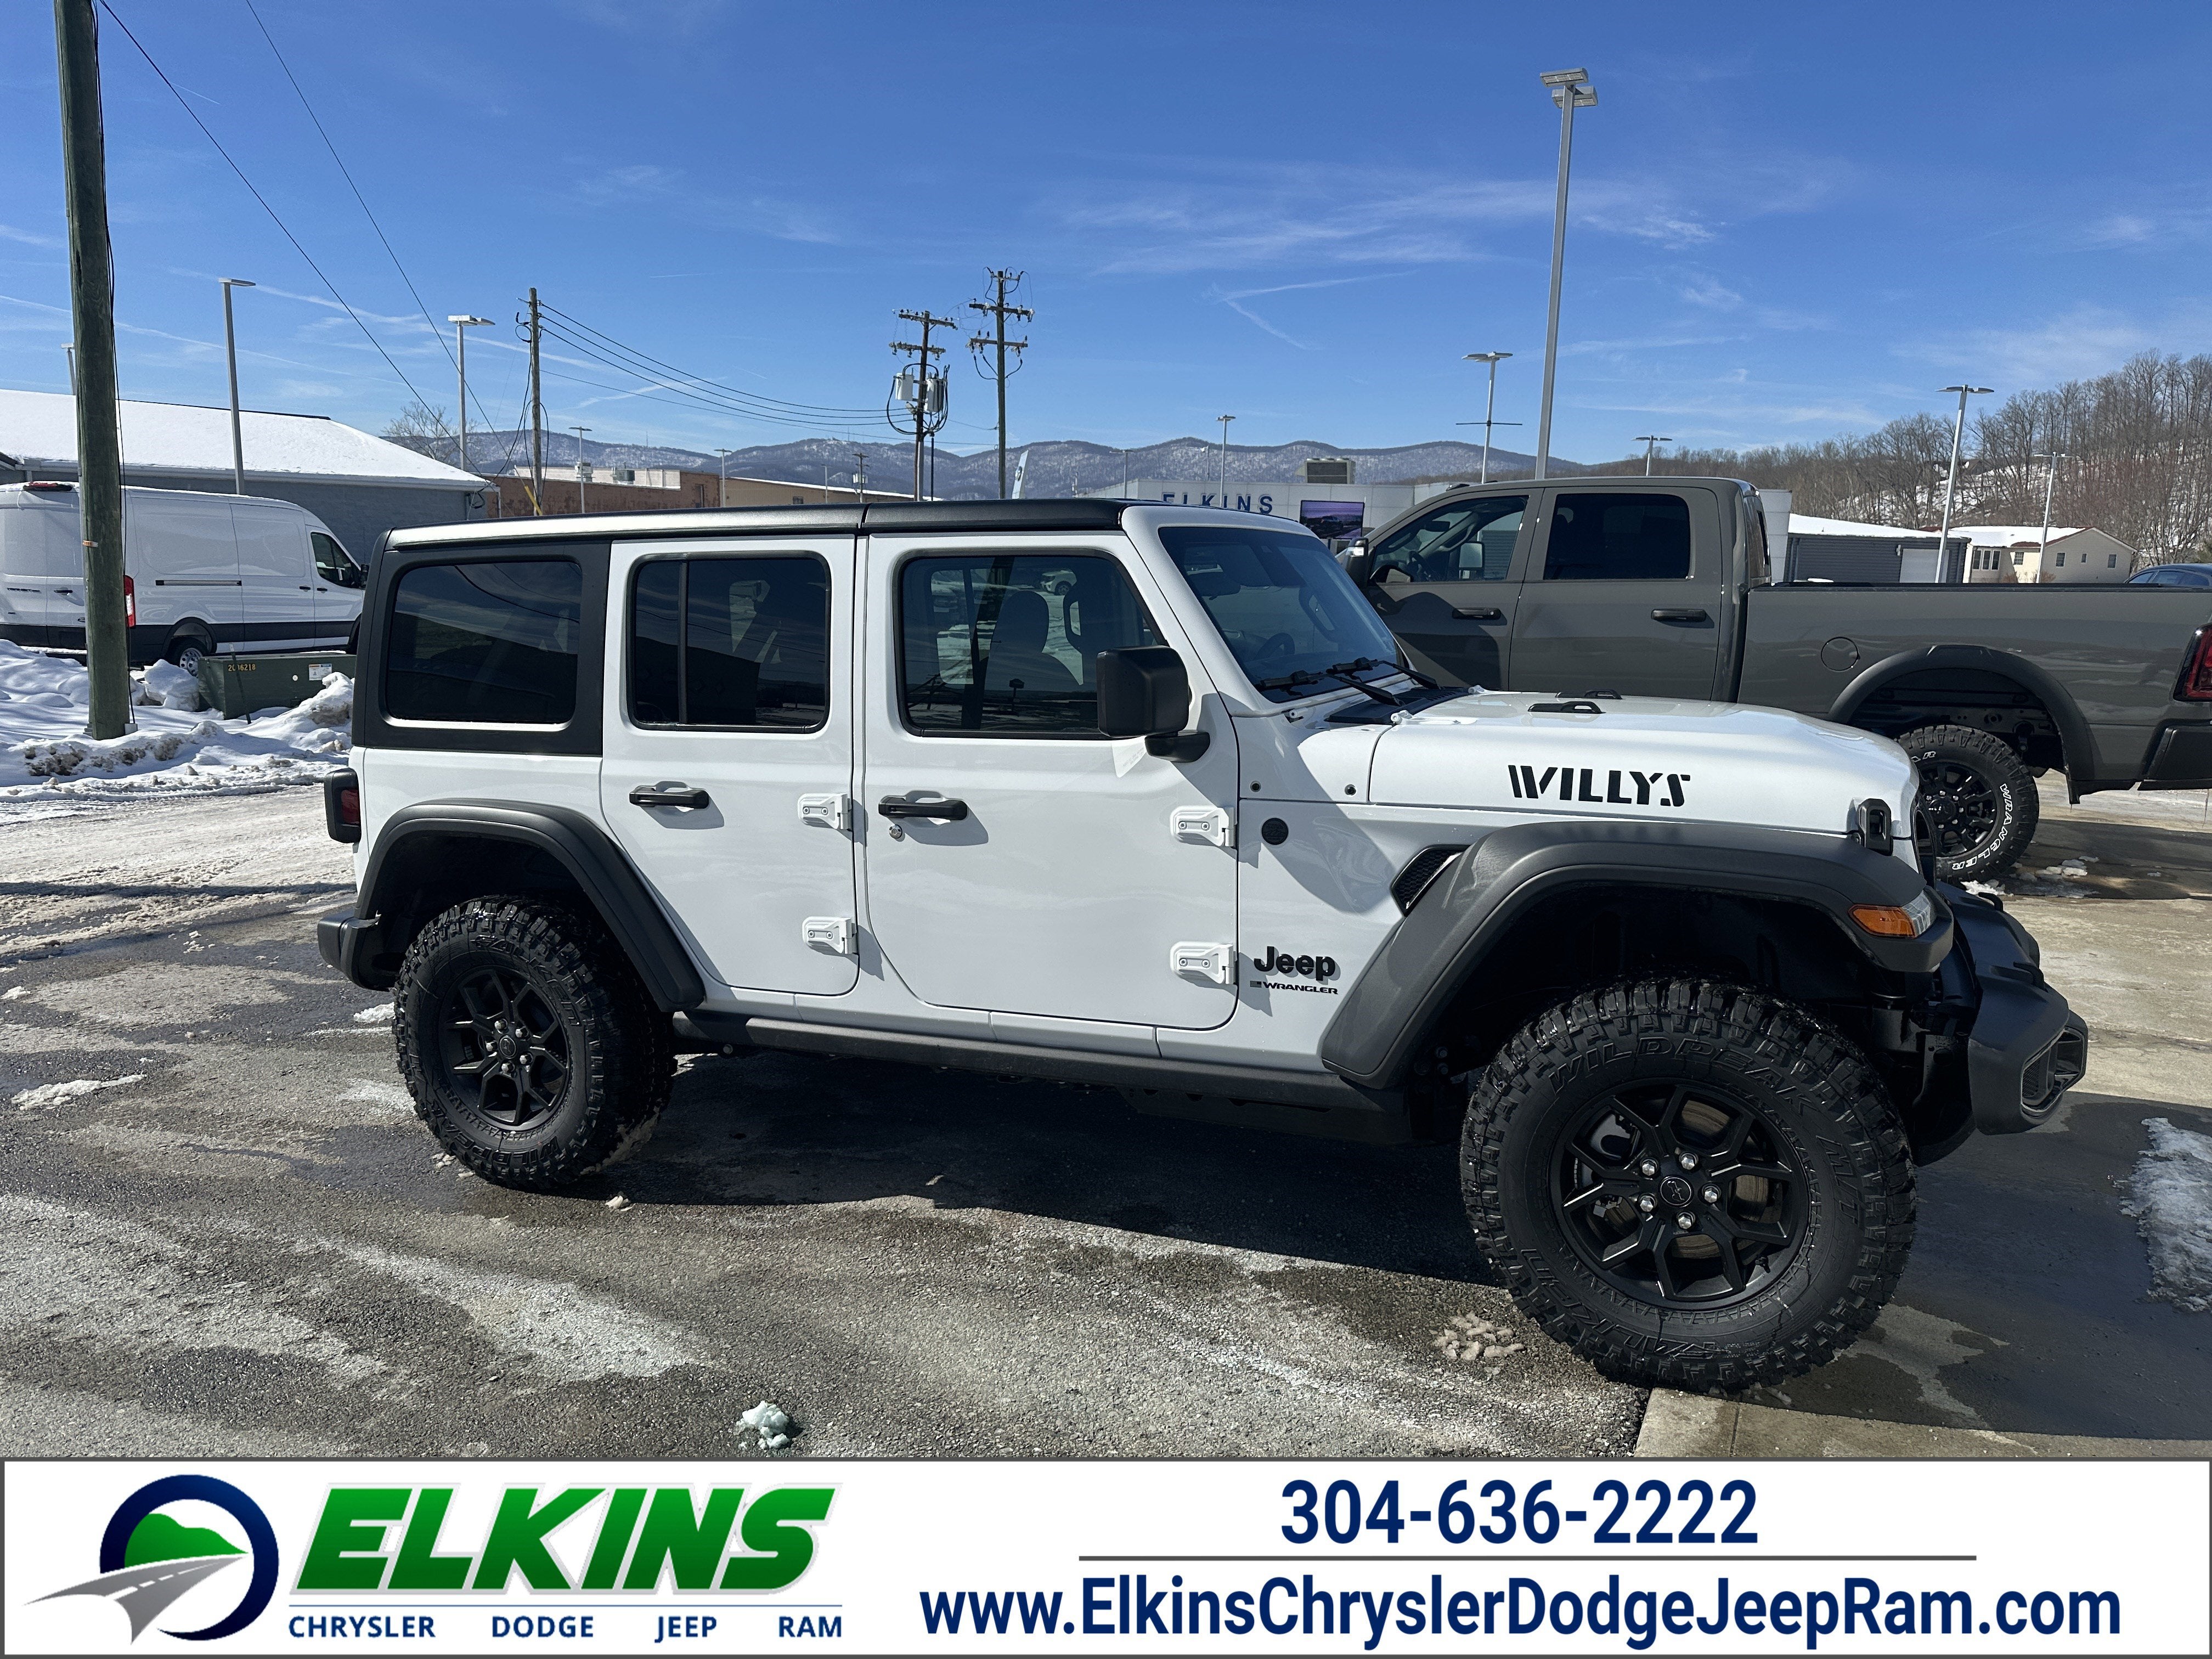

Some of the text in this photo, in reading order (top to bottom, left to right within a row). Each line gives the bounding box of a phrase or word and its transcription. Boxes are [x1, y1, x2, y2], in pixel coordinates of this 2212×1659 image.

[1508, 765, 1690, 807] WILLYS
[1952, 783, 2013, 870] WRANGLER
[1254, 946, 1336, 981] Jeep
[1263, 981, 1339, 995] WRANGLER
[1548, 1037, 1815, 1116] WILDPEAK
